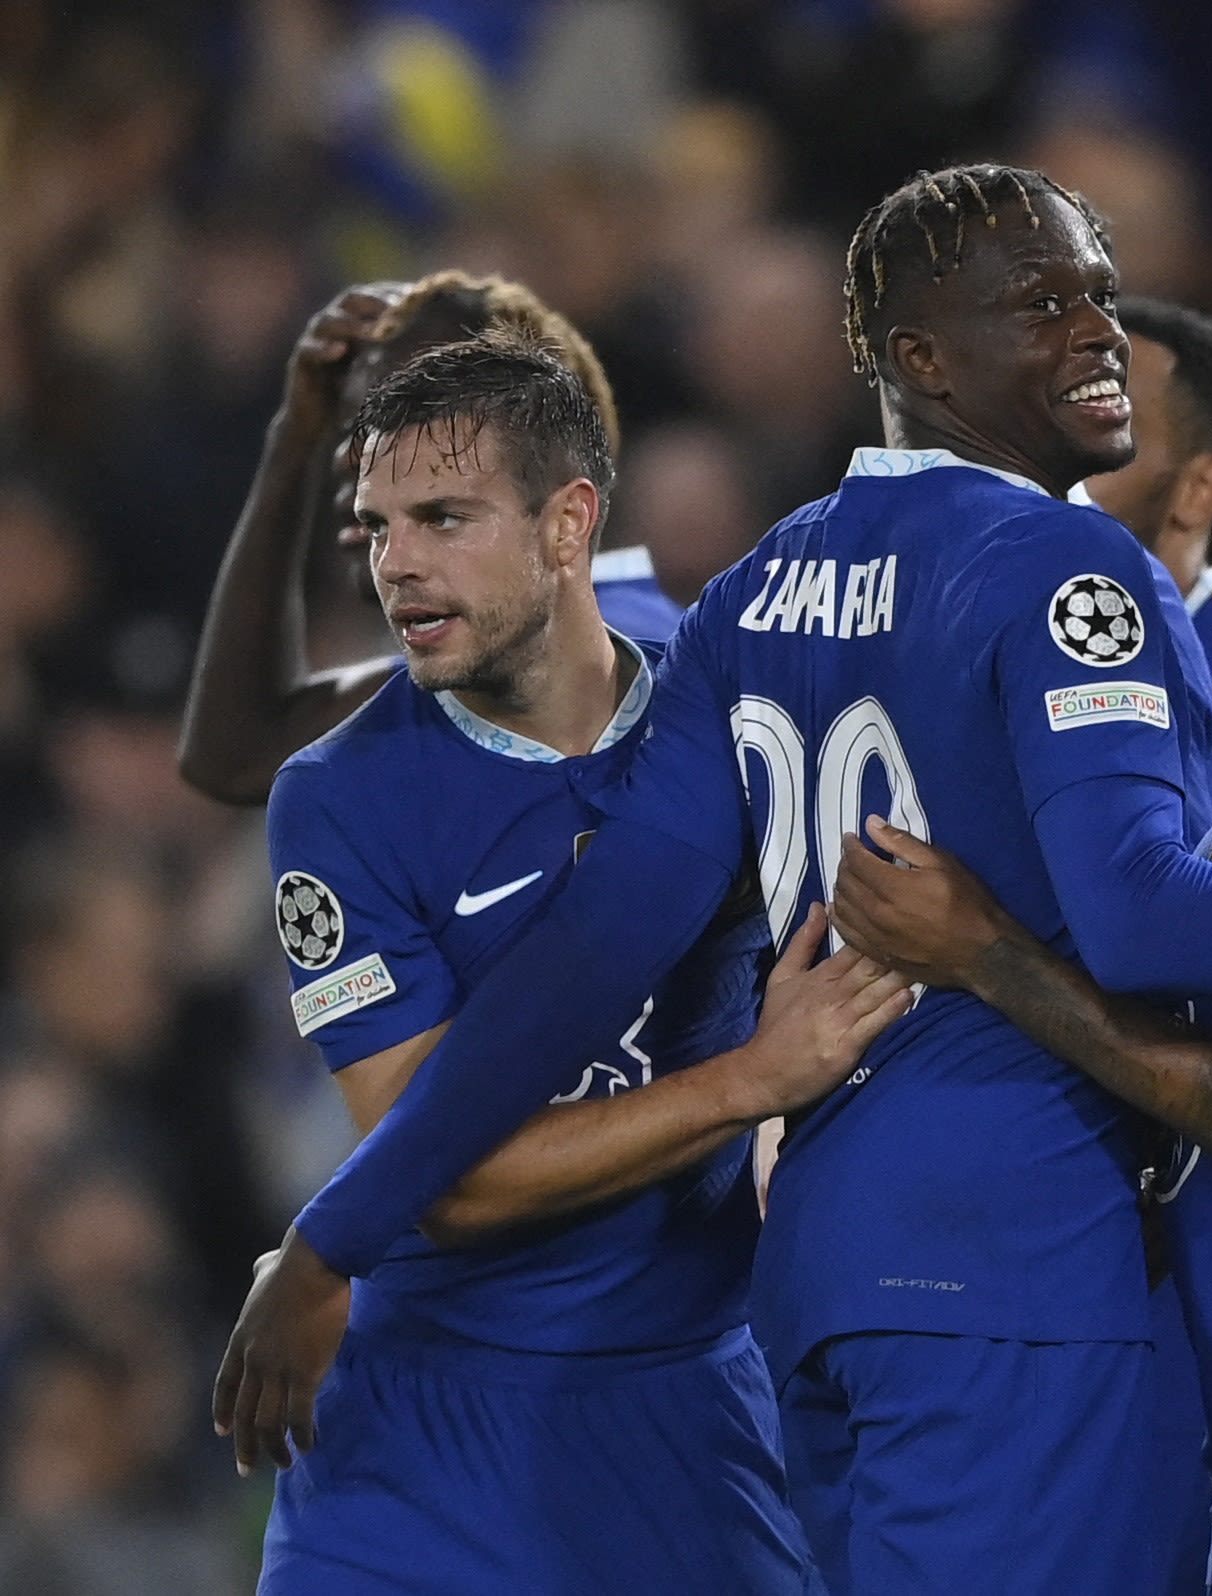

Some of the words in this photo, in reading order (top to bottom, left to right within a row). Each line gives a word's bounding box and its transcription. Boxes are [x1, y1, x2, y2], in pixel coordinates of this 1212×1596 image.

[1050, 690, 1078, 702] UEFA
[1051, 694, 1166, 717] FOUNDATION
[296, 967, 386, 1018] FOUNDATION
